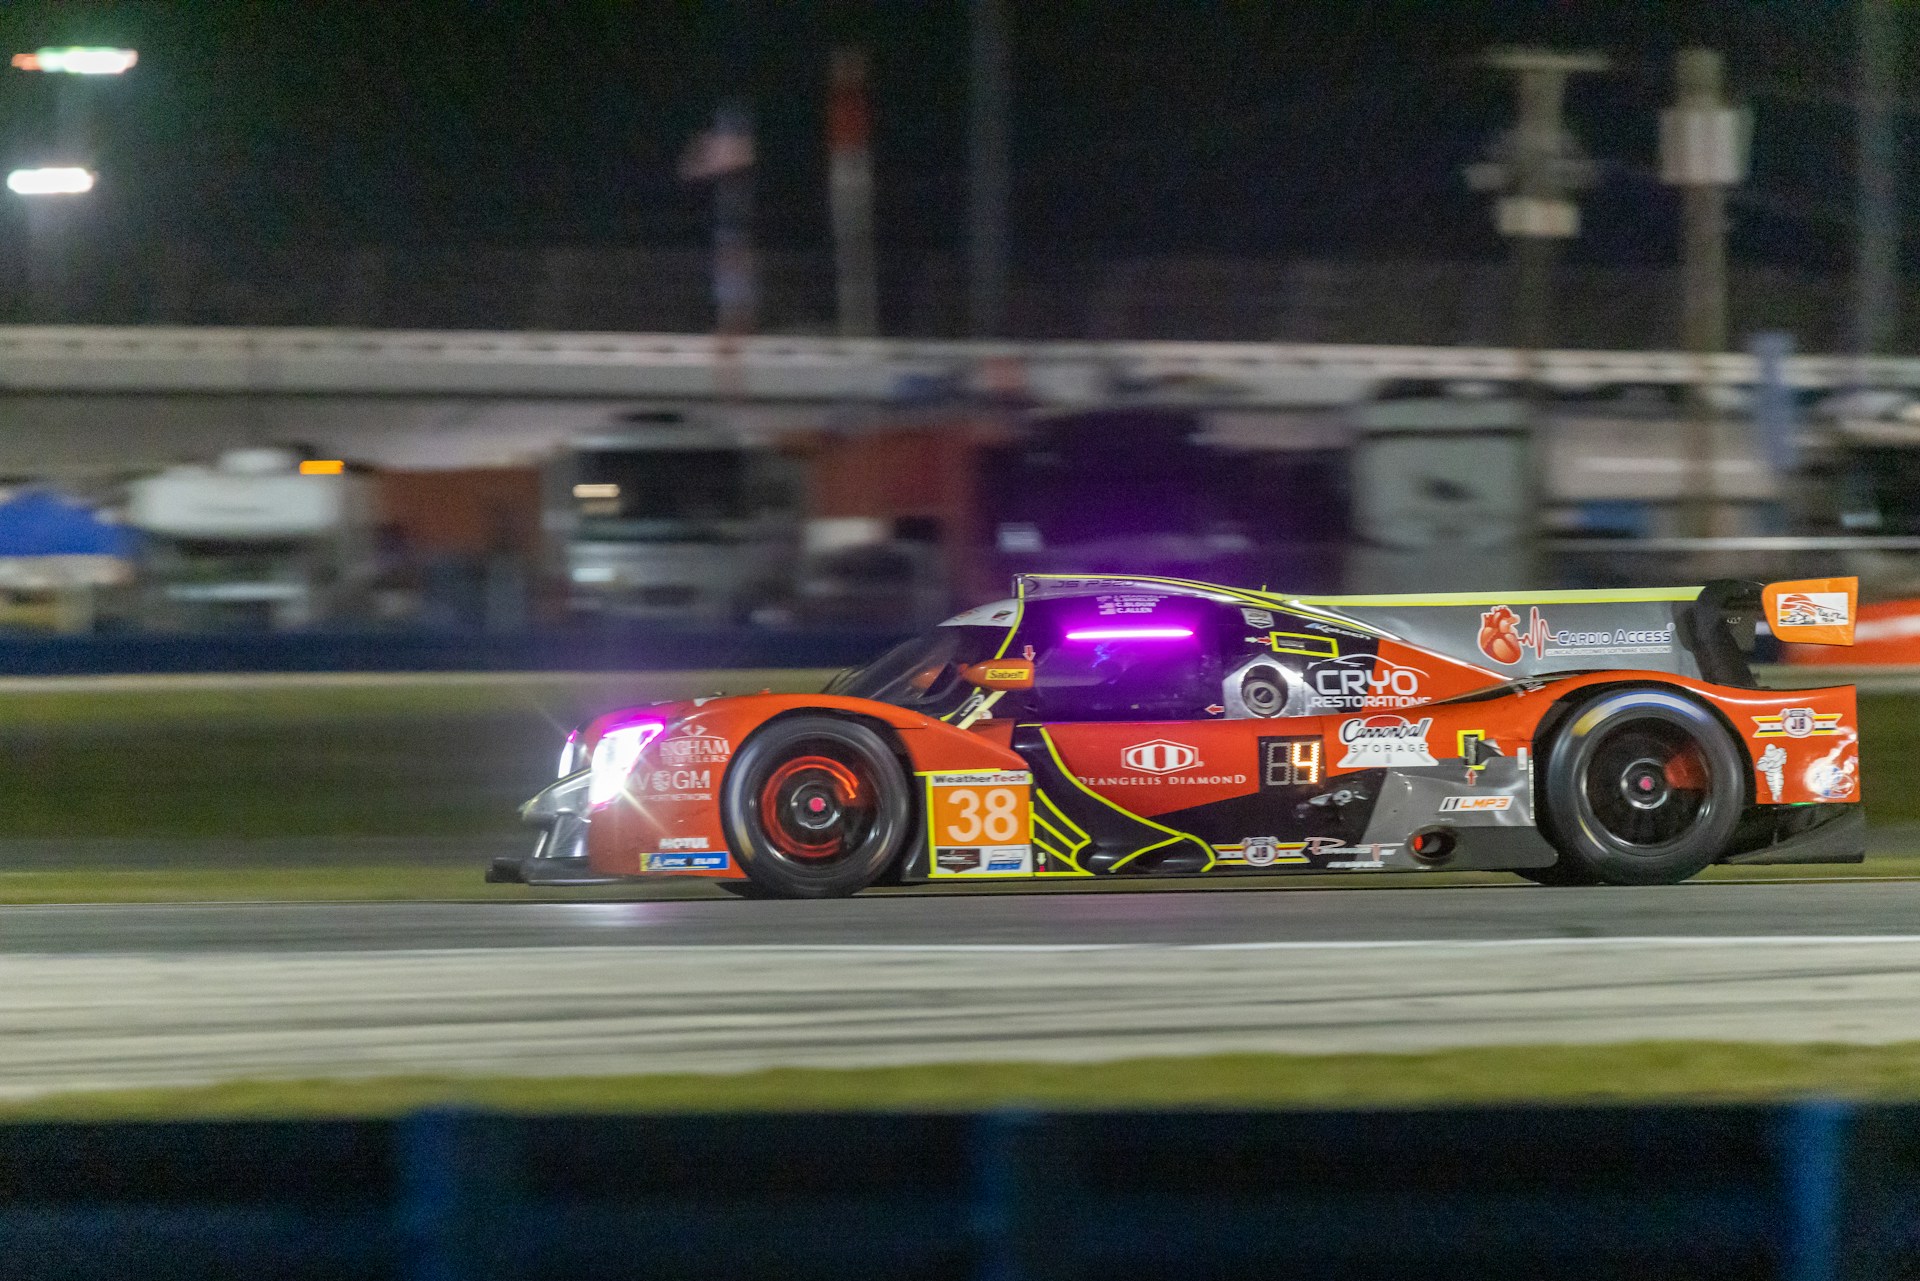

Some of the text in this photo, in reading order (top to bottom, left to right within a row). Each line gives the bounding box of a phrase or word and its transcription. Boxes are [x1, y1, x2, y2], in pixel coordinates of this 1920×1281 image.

[1557, 629, 1672, 645] CARDIO ACCESS
[1315, 669, 1419, 696] CRYO
[1343, 718, 1430, 742] Cannonball
[1351, 744, 1428, 754] STORAGE
[1292, 741, 1320, 784] 4
[934, 773, 1026, 784] WeatherTech
[1168, 774, 1247, 785] DIAMOND
[1460, 798, 1509, 809] LMP3
[947, 788, 1019, 842] 38
